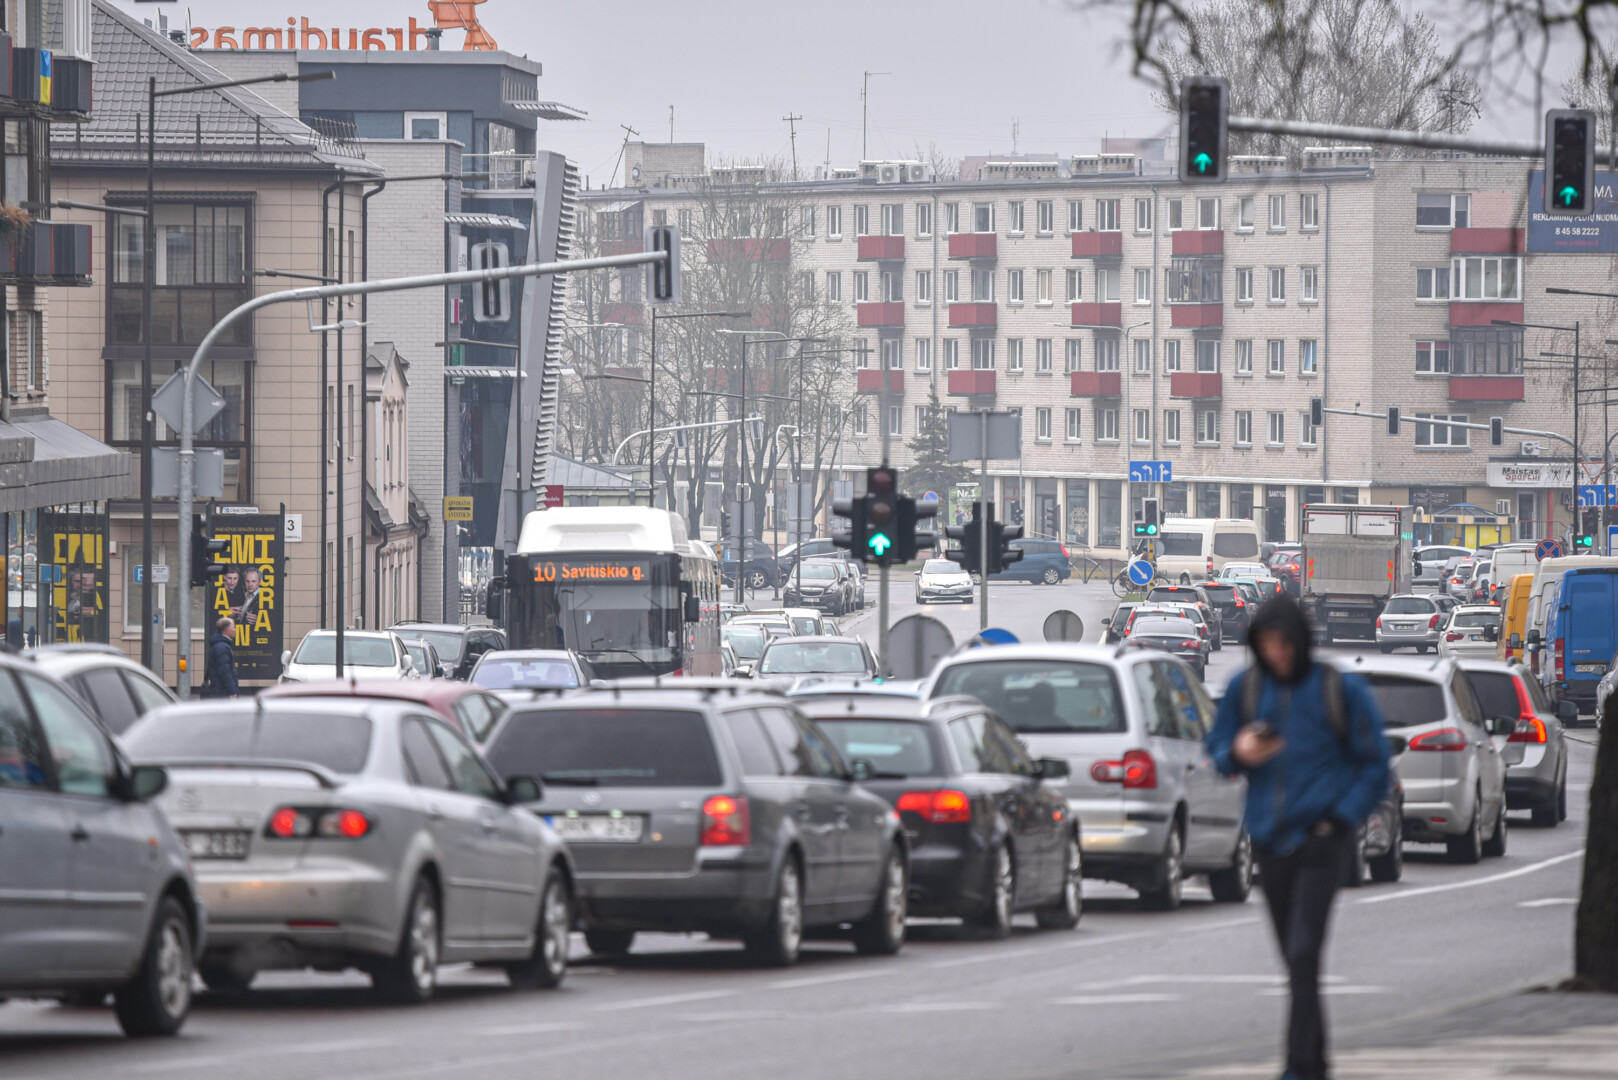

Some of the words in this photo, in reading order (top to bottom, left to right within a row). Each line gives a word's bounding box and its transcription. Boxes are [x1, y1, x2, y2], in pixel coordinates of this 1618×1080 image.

[1582, 228, 1600, 236] 2222
[1502, 467, 1540, 475] Maistas
[287, 520, 295, 531] 3
[534, 562, 556, 582] 10
[632, 566, 644, 580] g.
